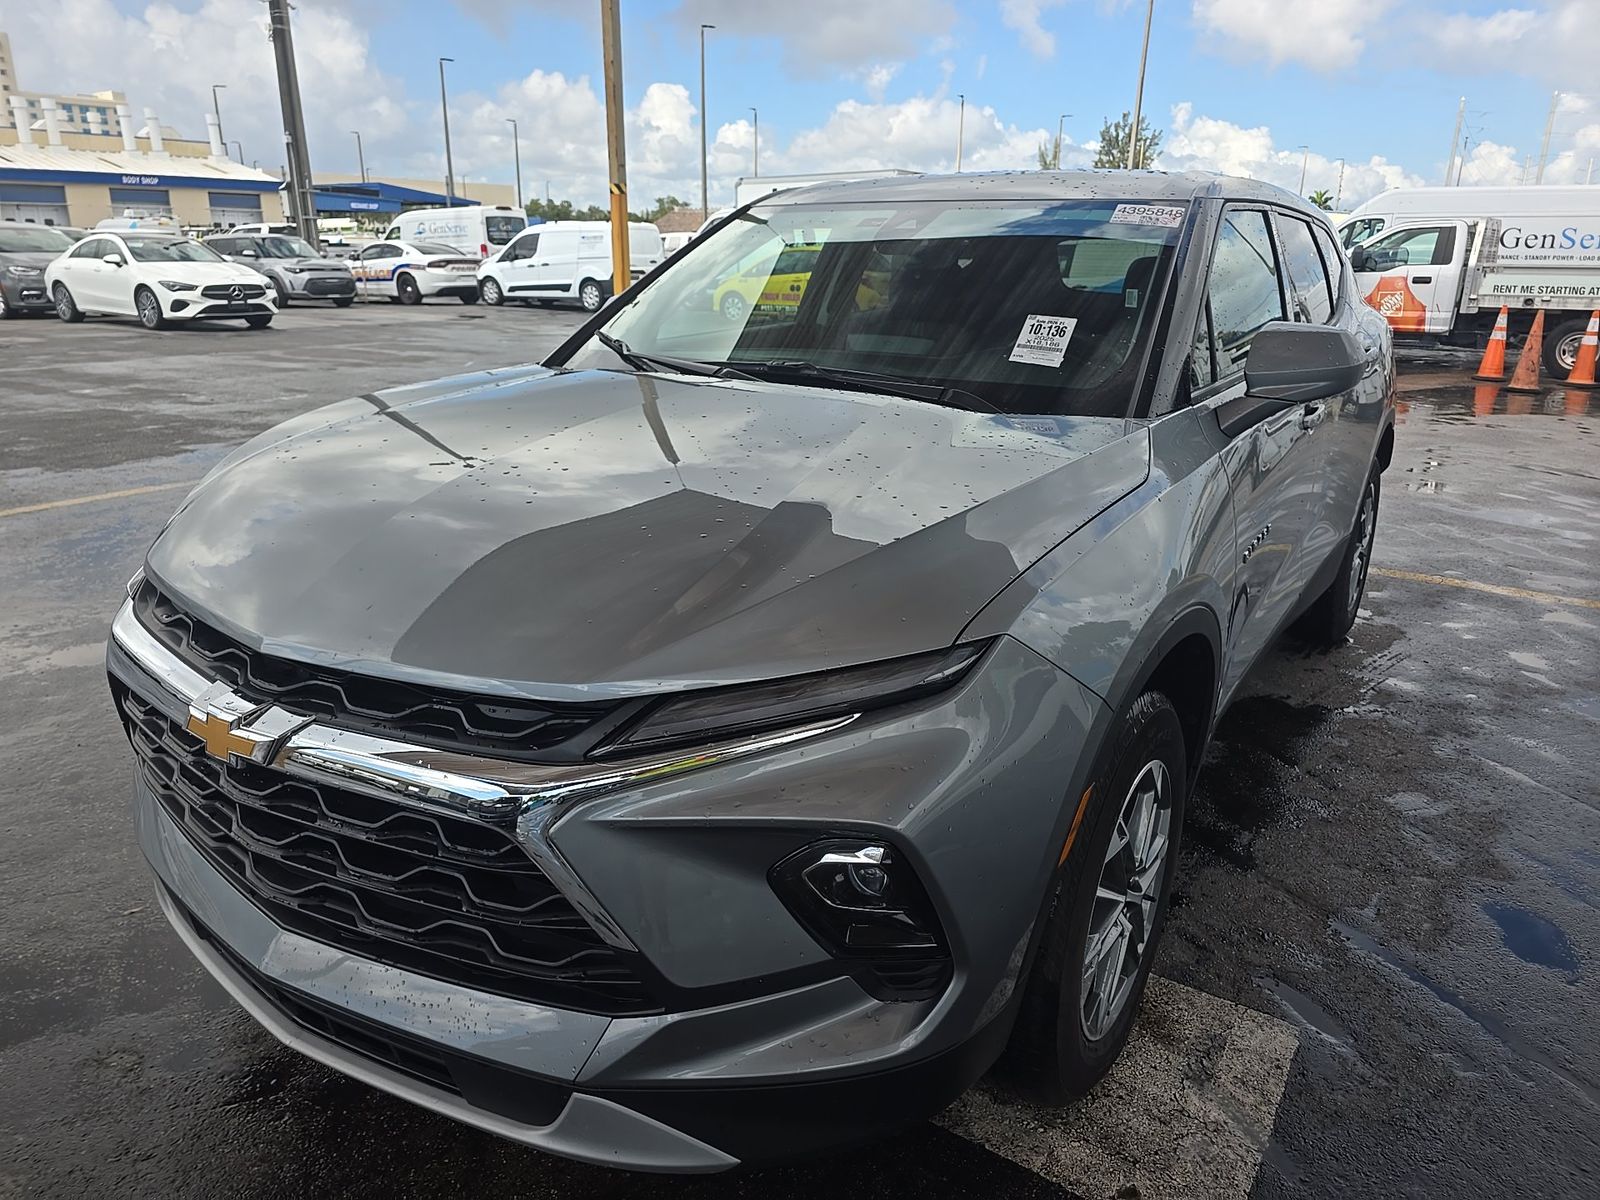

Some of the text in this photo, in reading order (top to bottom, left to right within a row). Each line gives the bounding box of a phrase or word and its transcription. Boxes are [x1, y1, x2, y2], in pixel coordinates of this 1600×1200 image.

[122, 175, 159, 185] BODY SHOP
[1493, 284, 1600, 296] RENT ME STARTING AT
[1028, 323, 1068, 338] 10:136
